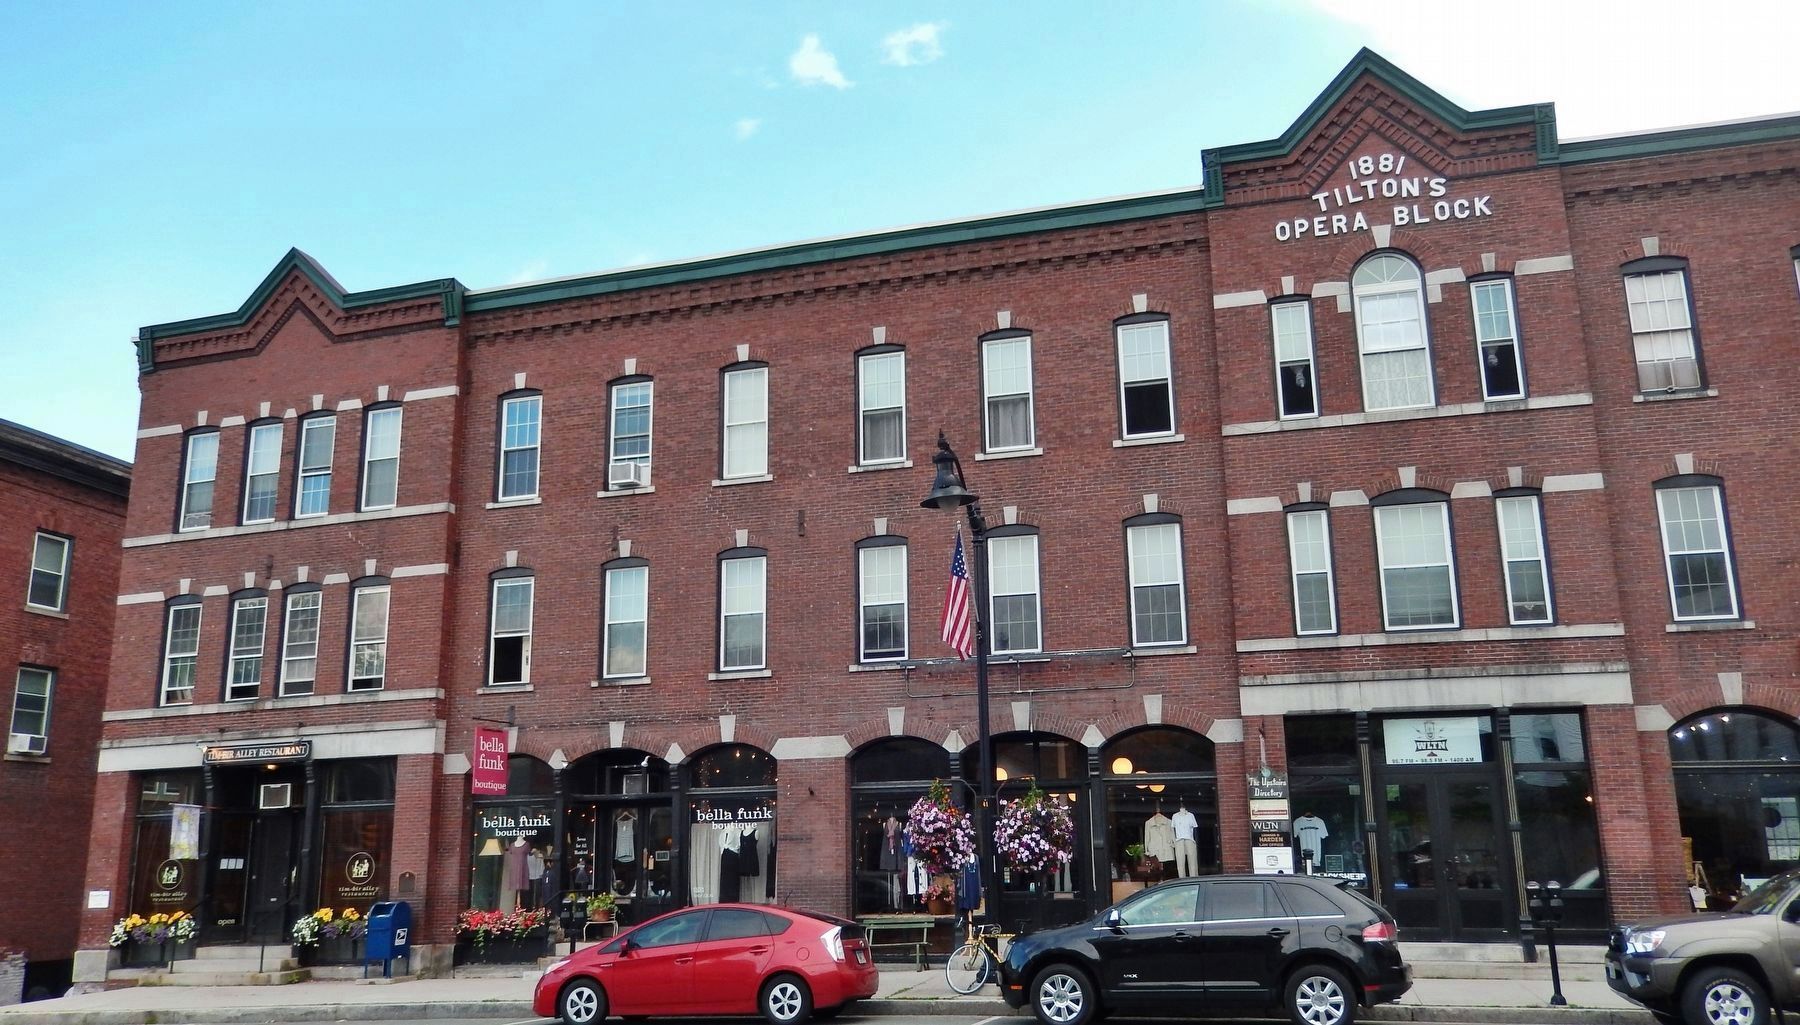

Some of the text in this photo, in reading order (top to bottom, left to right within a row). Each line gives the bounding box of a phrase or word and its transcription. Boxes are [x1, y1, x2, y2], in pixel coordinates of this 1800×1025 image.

[1349, 153, 1405, 180] 1881
[1312, 176, 1447, 212] TILTON'S
[1275, 195, 1492, 242] OPERA BLOCK
[480, 736, 505, 753] bella
[1416, 741, 1446, 750] WLTN
[235, 748, 258, 759] ALLEY
[259, 745, 306, 757] RESTAURANT
[479, 754, 505, 771] funk
[474, 779, 507, 791] boutique
[1249, 776, 1287, 787] The Upstairs
[1254, 787, 1283, 798] Directory
[696, 806, 773, 821] bella funk
[482, 814, 552, 829] bella funk
[711, 820, 758, 831] boutique
[1252, 821, 1279, 830] WLTN
[495, 827, 538, 838] boutique
[217, 918, 236, 927] open
